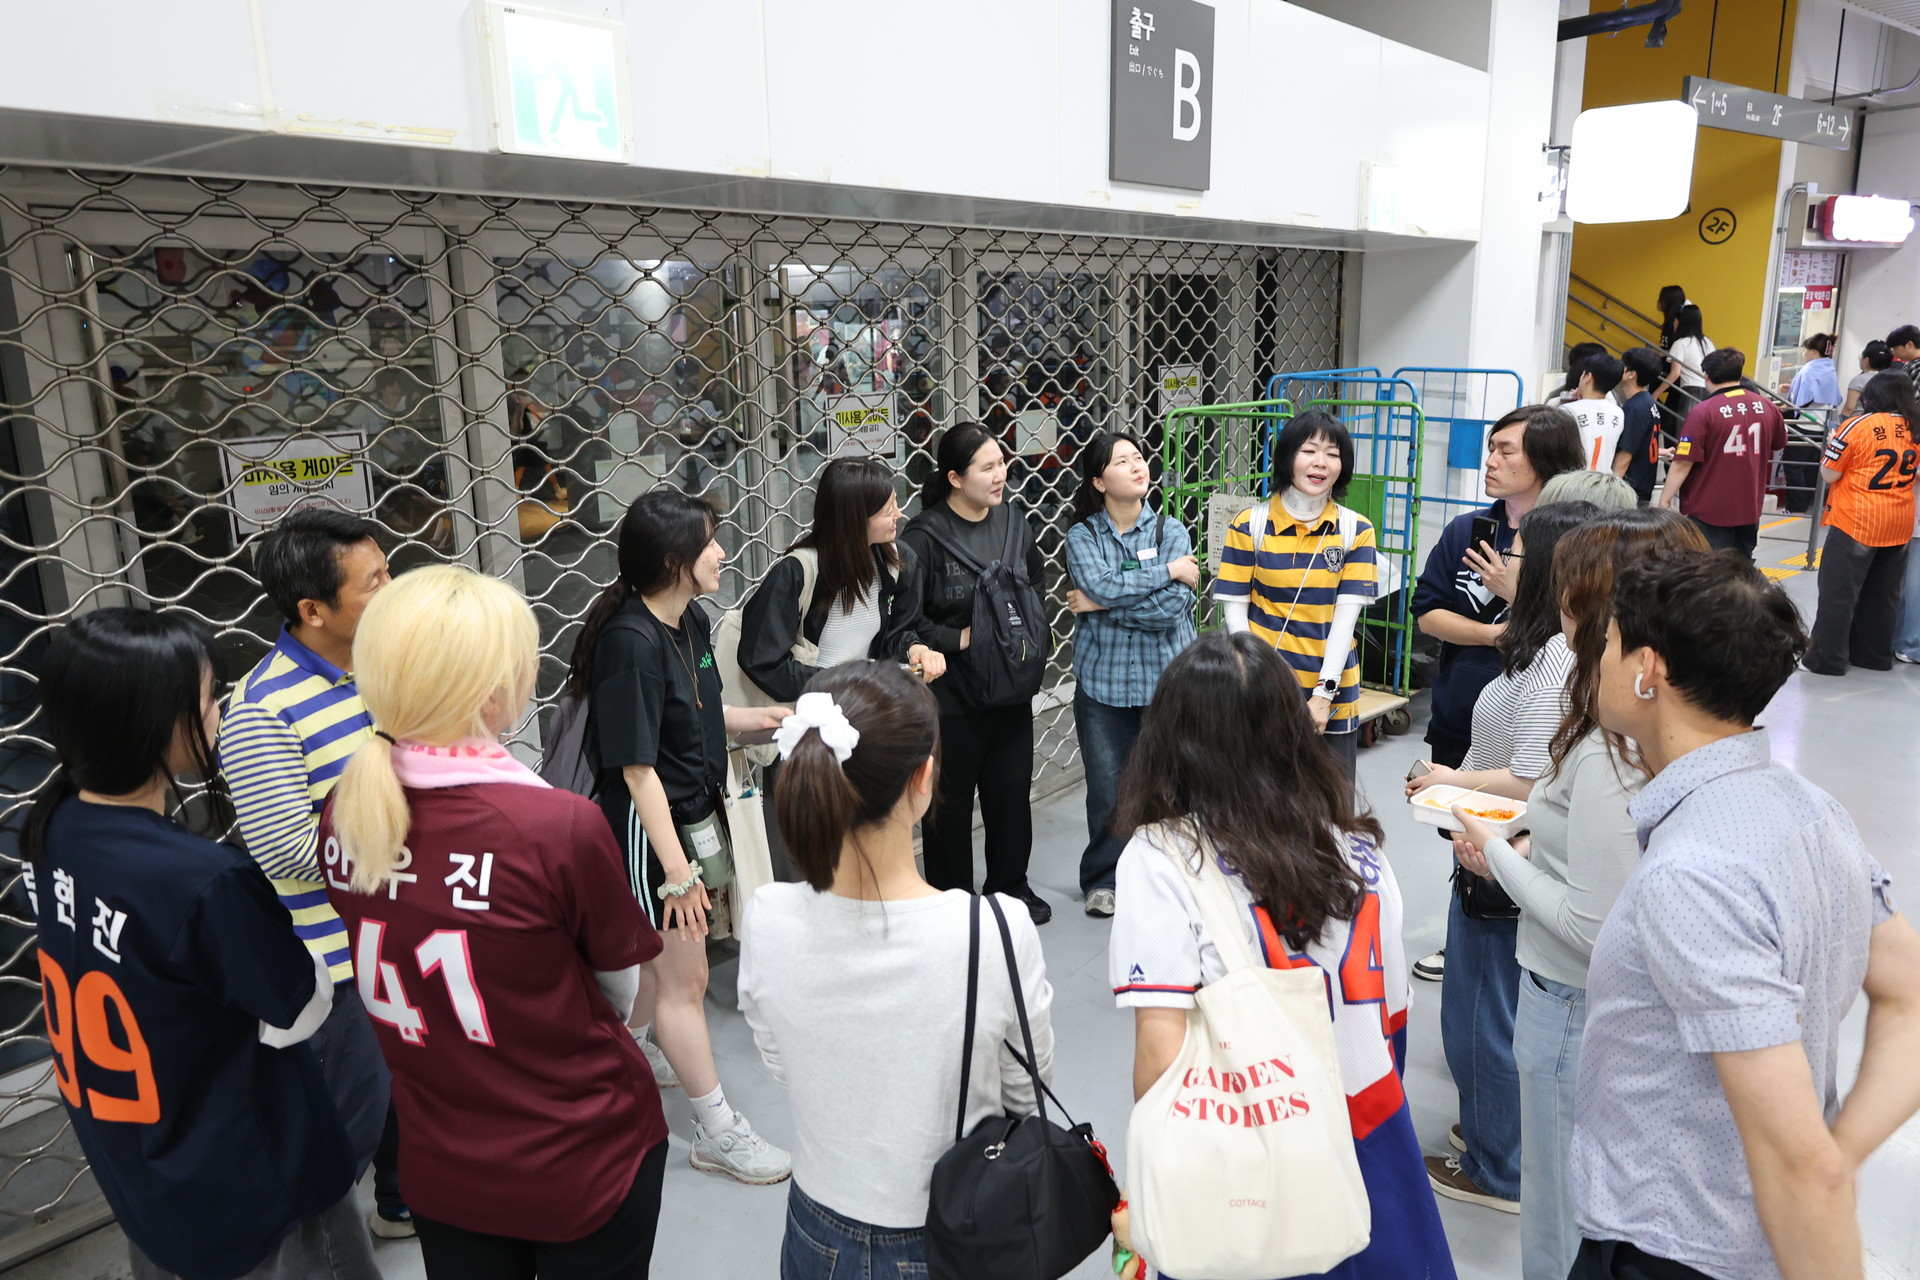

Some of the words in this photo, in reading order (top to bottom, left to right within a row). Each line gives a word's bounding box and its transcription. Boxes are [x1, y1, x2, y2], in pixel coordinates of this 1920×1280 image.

[1129, 7, 1155, 41] 출구
[1129, 44, 1140, 56] Exit
[1172, 48, 1202, 142] B
[1711, 91, 1728, 116] 1~5
[1771, 104, 1783, 126] 2F
[1817, 113, 1835, 136] 6~12
[1706, 217, 1730, 235] 2F
[835, 411, 862, 425] 미사용
[1578, 412, 1620, 428] 문동주
[1719, 401, 1765, 419] 안우진
[1590, 435, 1603, 471] 1
[1723, 422, 1761, 456] 41
[269, 483, 290, 496] 임의
[355, 917, 496, 1047] 41
[37, 947, 161, 1124] 99
